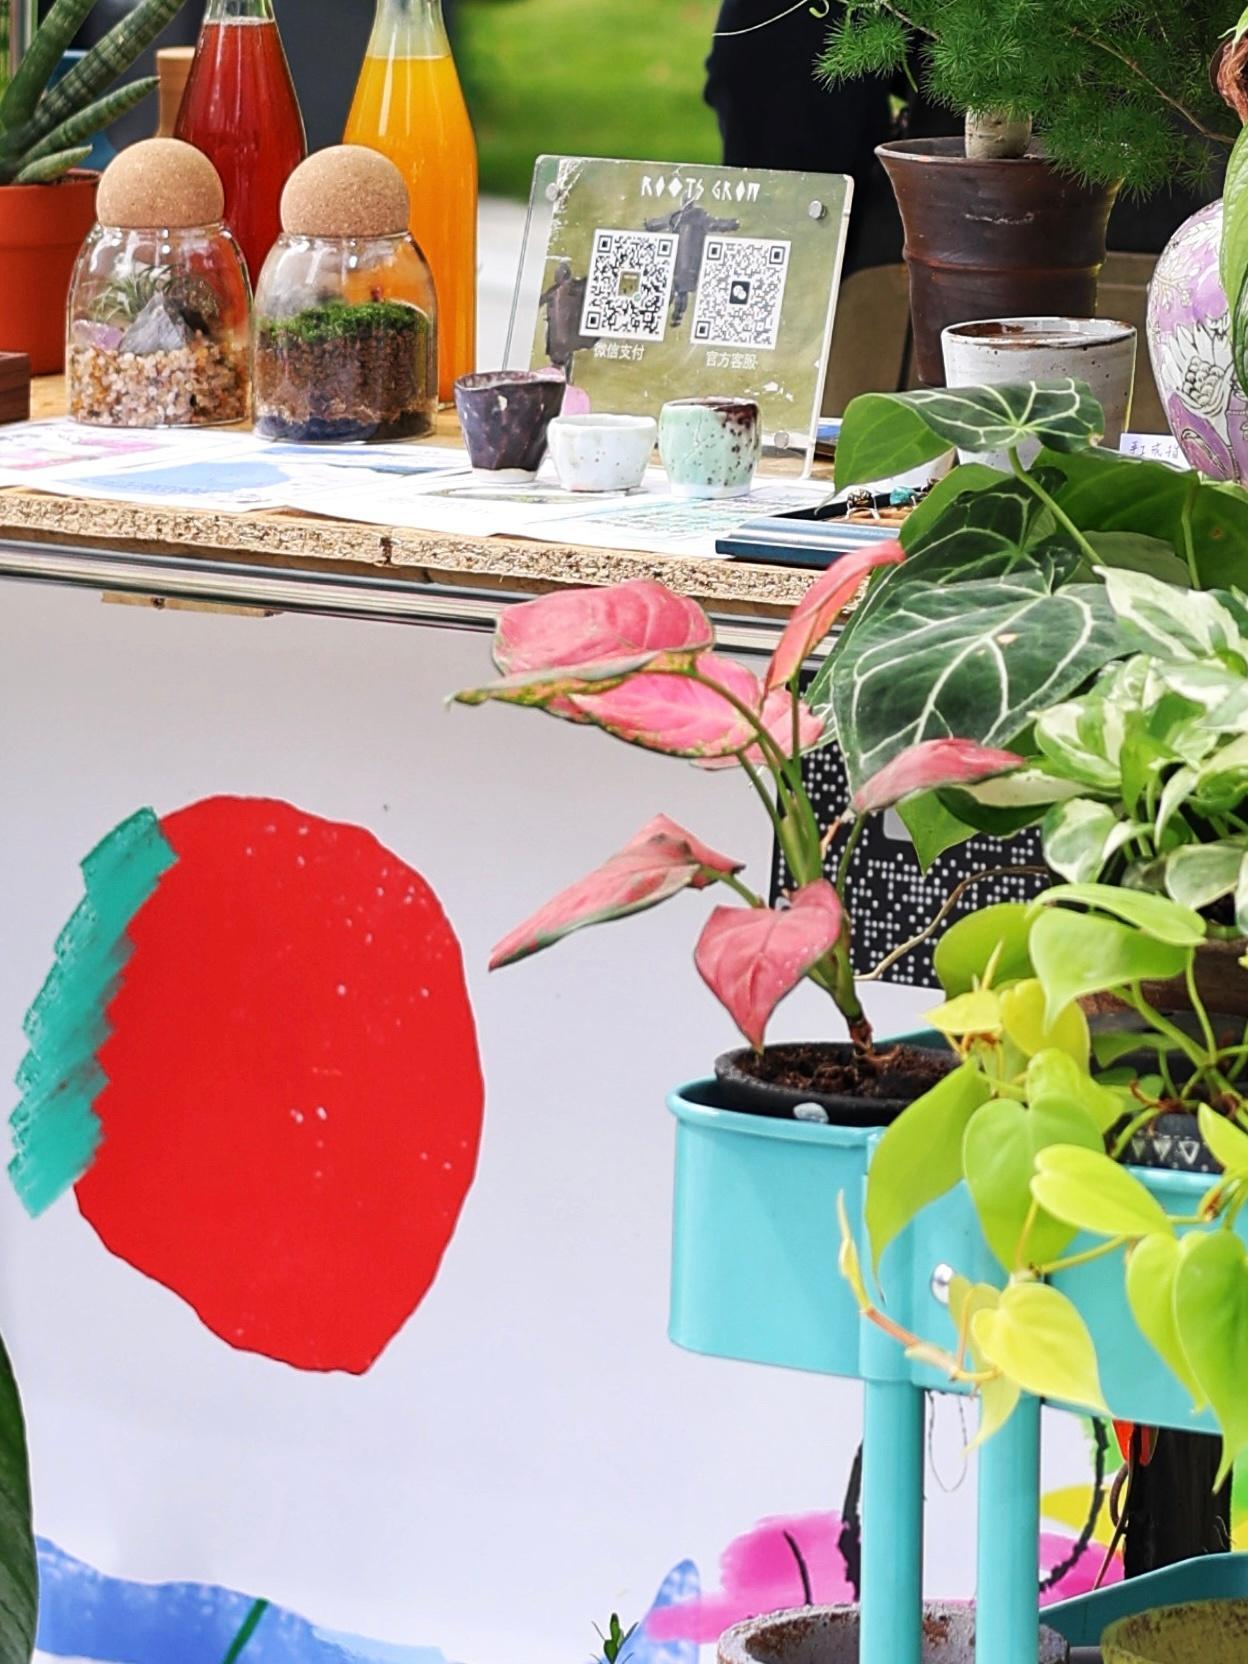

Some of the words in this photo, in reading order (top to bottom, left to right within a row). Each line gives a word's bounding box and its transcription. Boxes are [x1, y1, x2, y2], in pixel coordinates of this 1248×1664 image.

[641, 175, 705, 201] ROOTS
[593, 342, 645, 361] 微信支付
[705, 350, 758, 370] 官方客服
